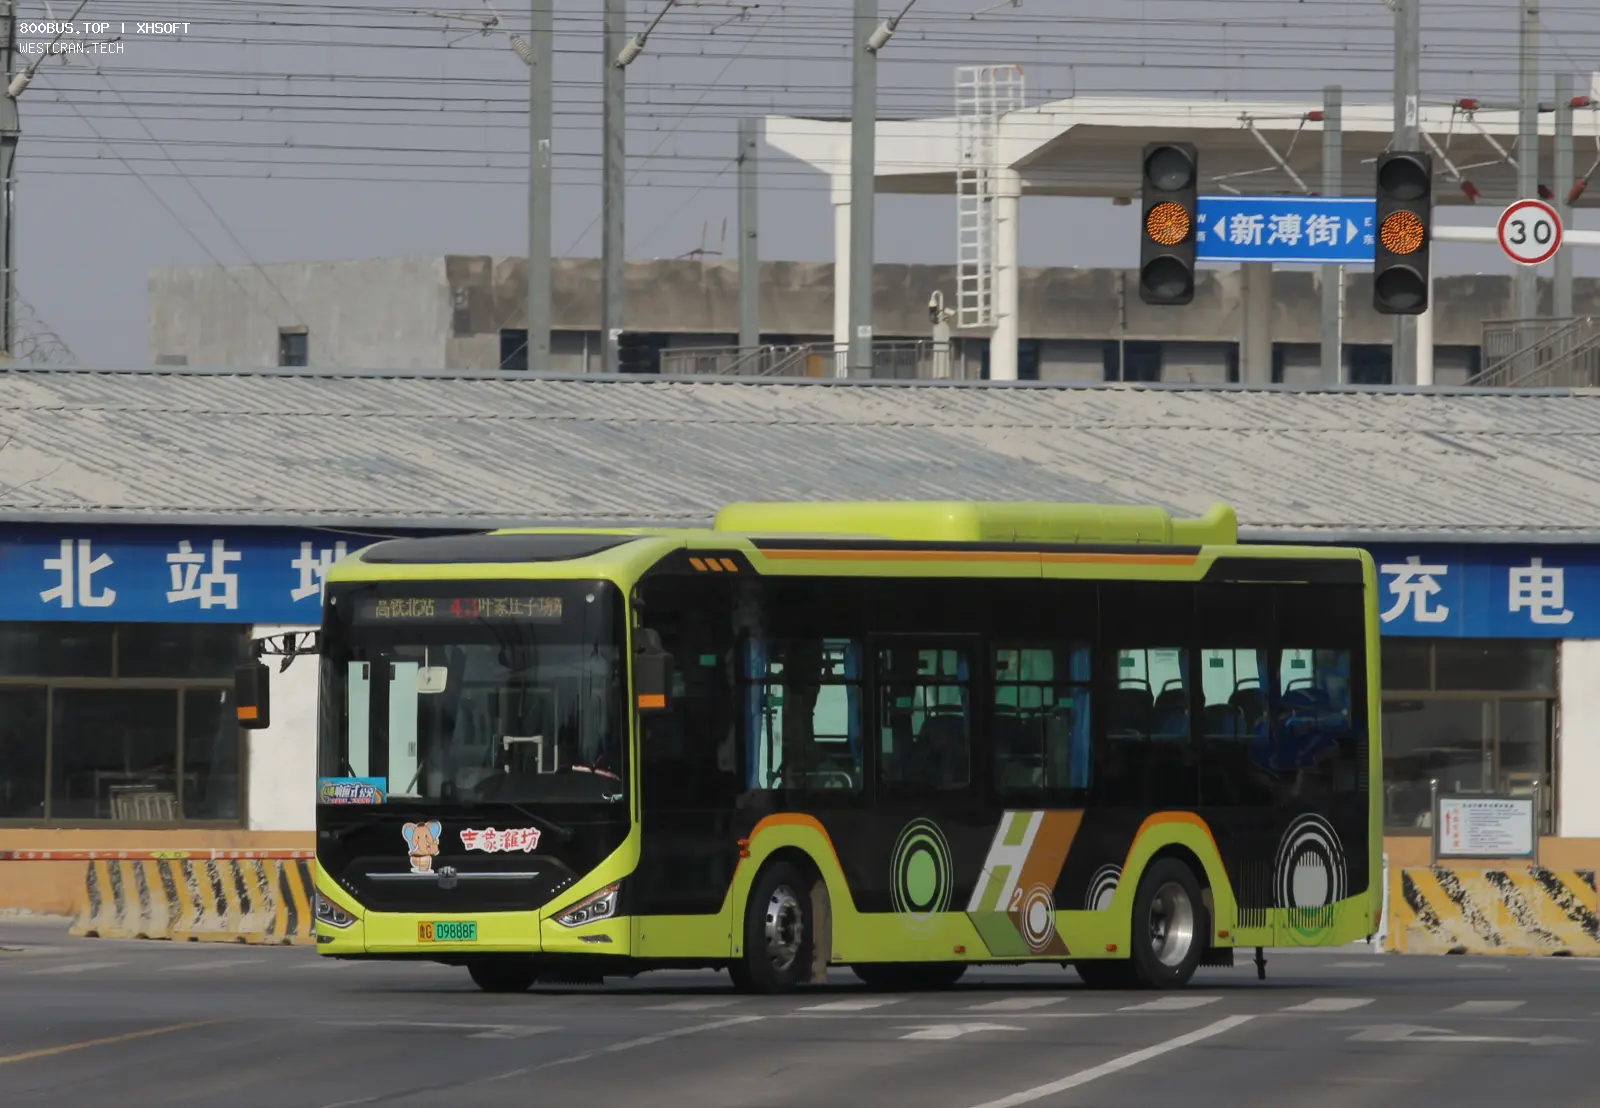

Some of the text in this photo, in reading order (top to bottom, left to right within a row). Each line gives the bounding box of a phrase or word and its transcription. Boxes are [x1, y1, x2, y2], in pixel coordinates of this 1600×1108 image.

[1229, 213, 1341, 246] 新溥街
[1364, 217, 1372, 227] E
[1509, 219, 1552, 245] 30
[1363, 234, 1375, 245] 东
[375, 598, 435, 619] 高铁北站
